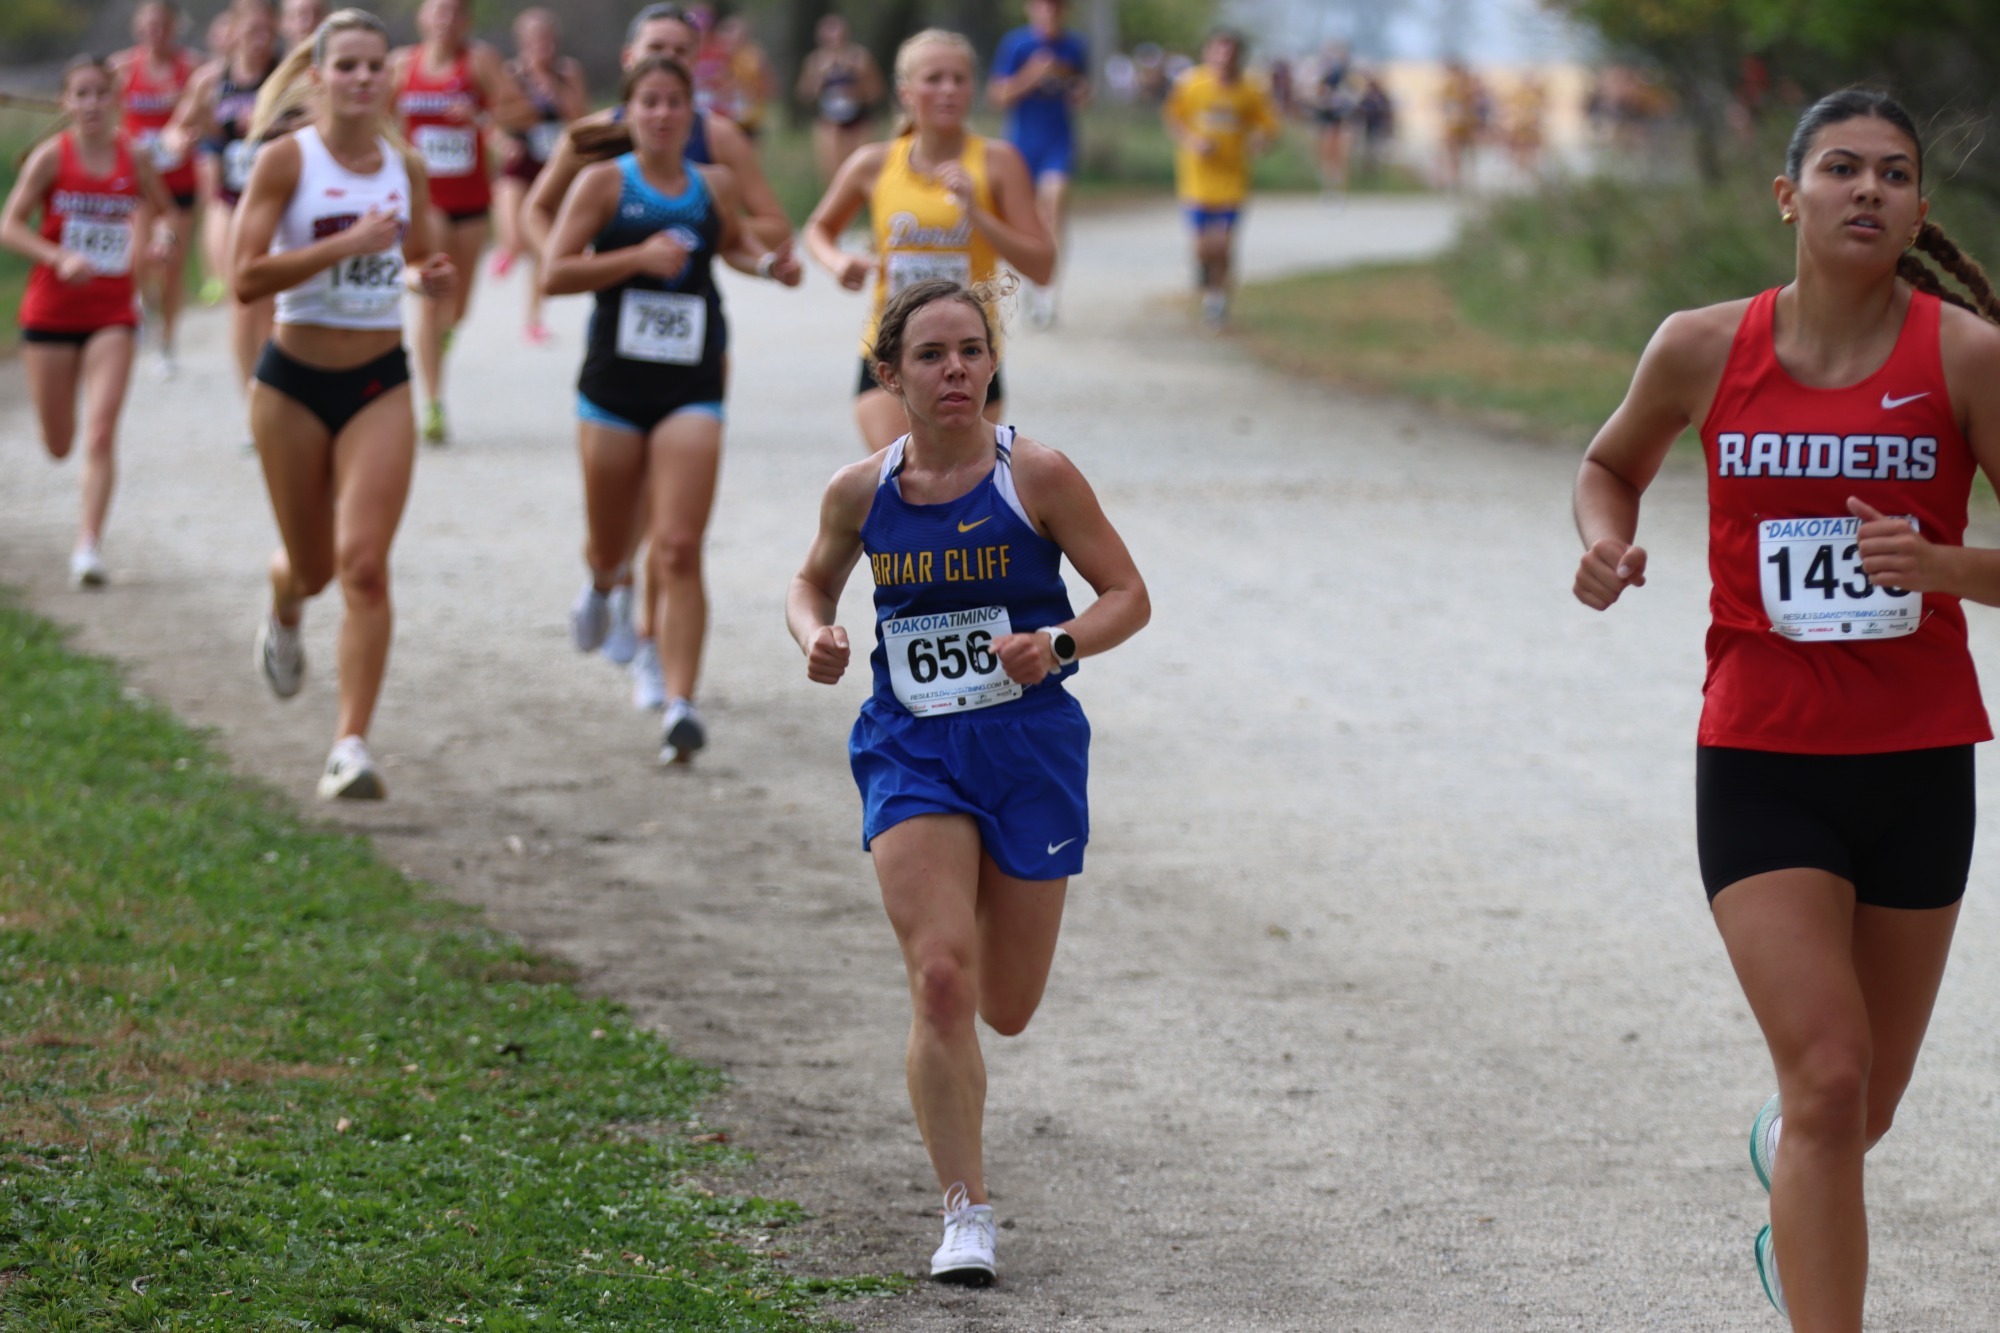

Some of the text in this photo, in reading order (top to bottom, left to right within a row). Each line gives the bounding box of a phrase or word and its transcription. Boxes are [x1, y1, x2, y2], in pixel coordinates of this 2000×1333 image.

[331, 255, 400, 288] 1482
[633, 304, 691, 339] 795
[1717, 432, 1938, 480] RAIDERS
[1769, 516, 1911, 538] DAKOTATI
[872, 545, 1011, 586] BRIAR CLIFF
[1767, 543, 1911, 602] 143
[892, 605, 999, 635] DAKOTATIMING
[907, 630, 998, 684] 656
